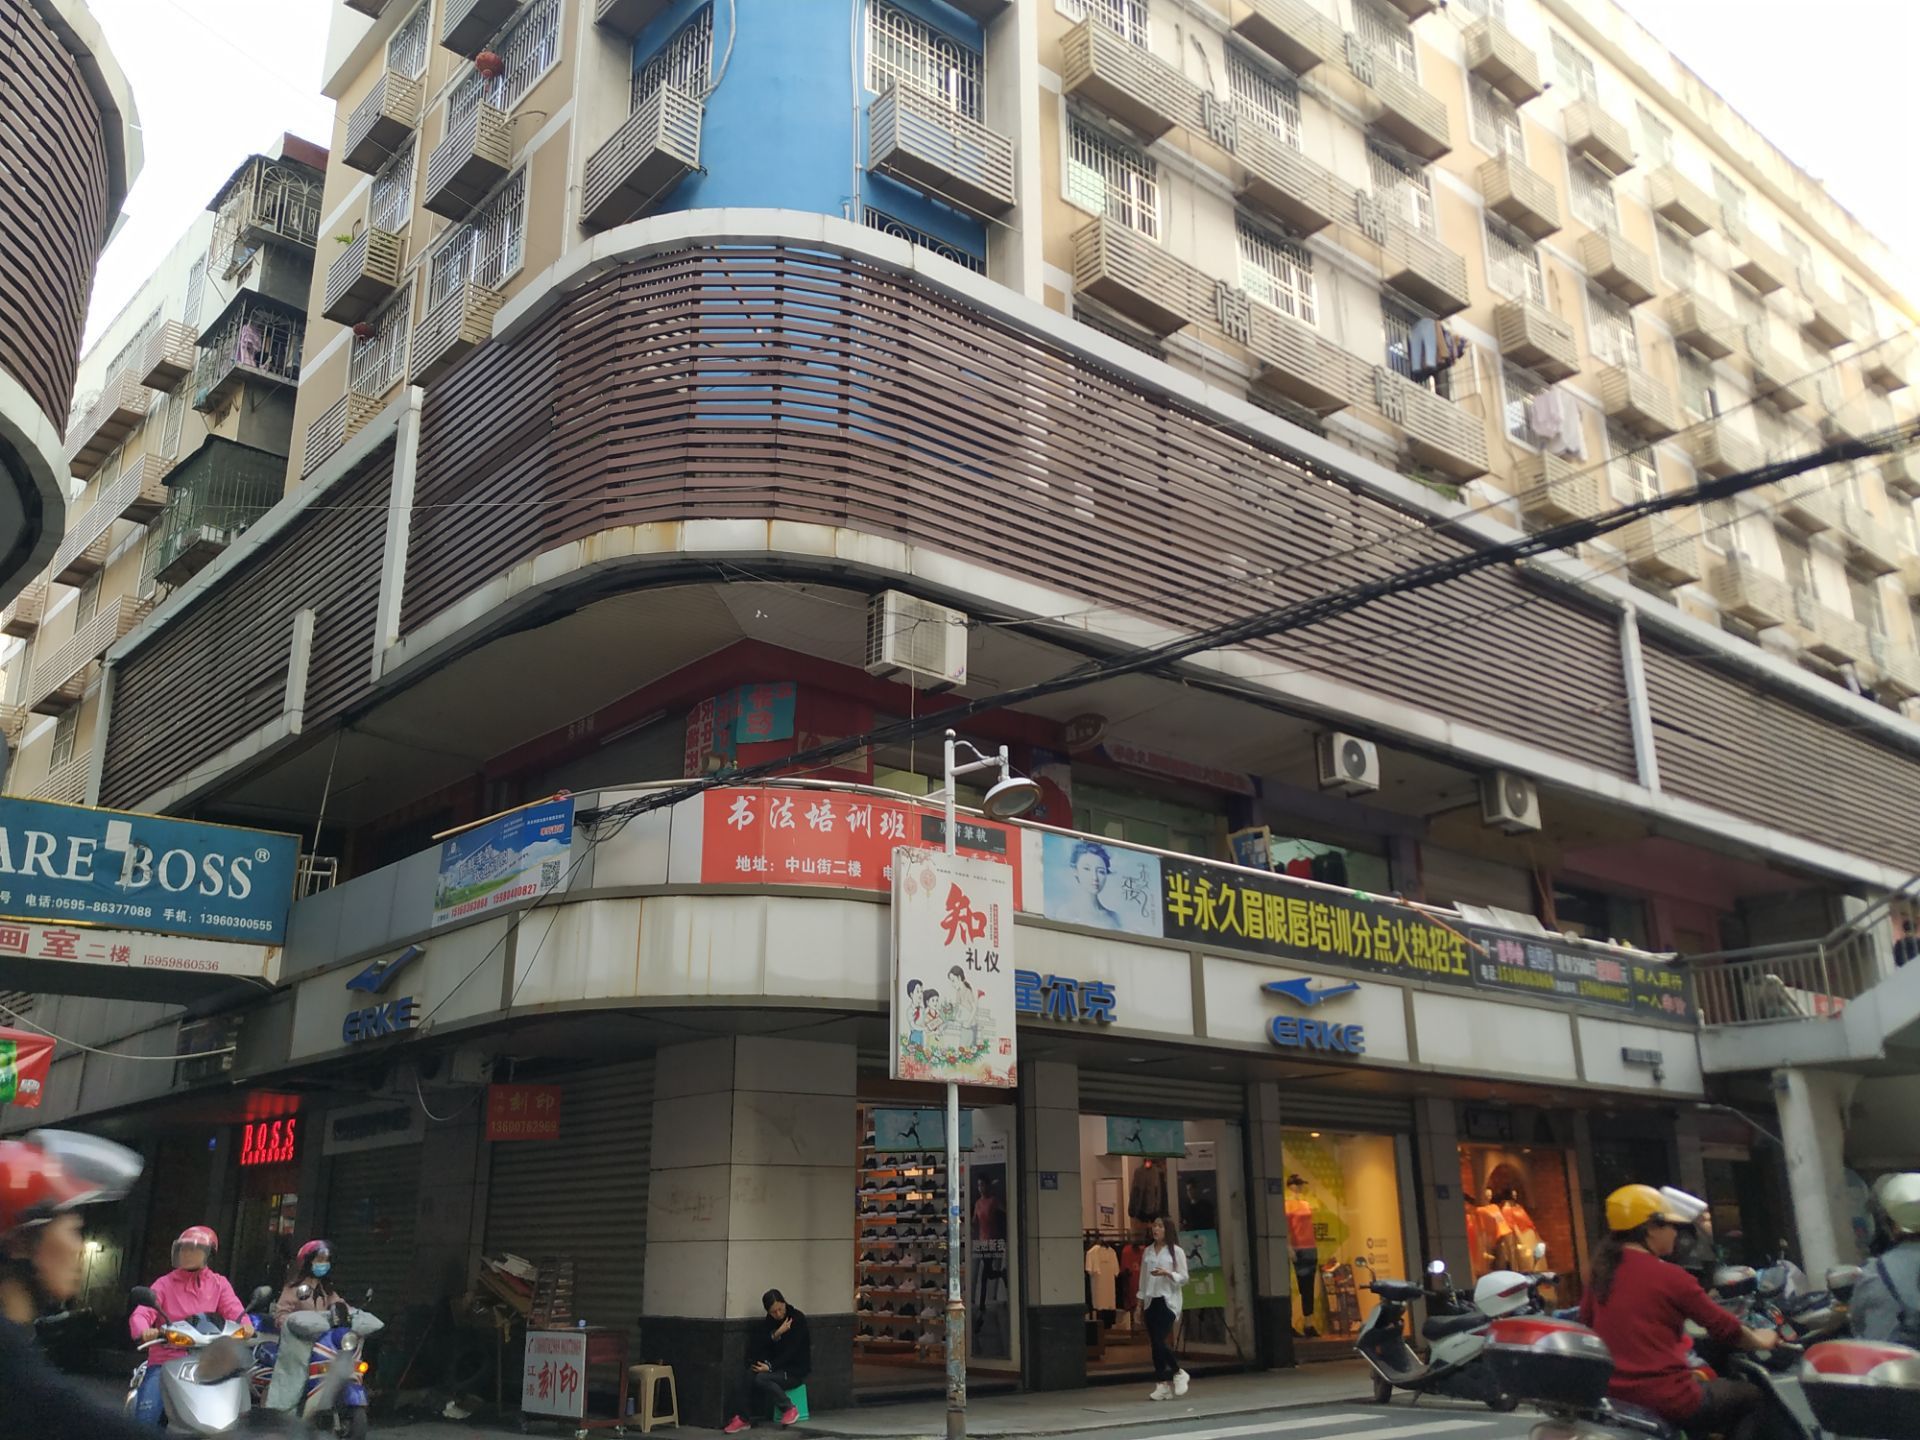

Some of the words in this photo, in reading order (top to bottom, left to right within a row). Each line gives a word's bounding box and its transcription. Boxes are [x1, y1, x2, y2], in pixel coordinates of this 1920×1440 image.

[727, 795, 907, 839] 书法培训班
[941, 882, 987, 946] 知
[1168, 872, 1470, 976] 半永久眉眼唇培训分点火热招生
[143, 954, 219, 971] 15959860536
[966, 948, 1000, 973] 礼仪
[1015, 969, 1117, 1023] 星尔克
[343, 996, 414, 1044] ERKE
[1267, 1014, 1366, 1054] ERKE
[244, 1118, 297, 1153] BOSS
